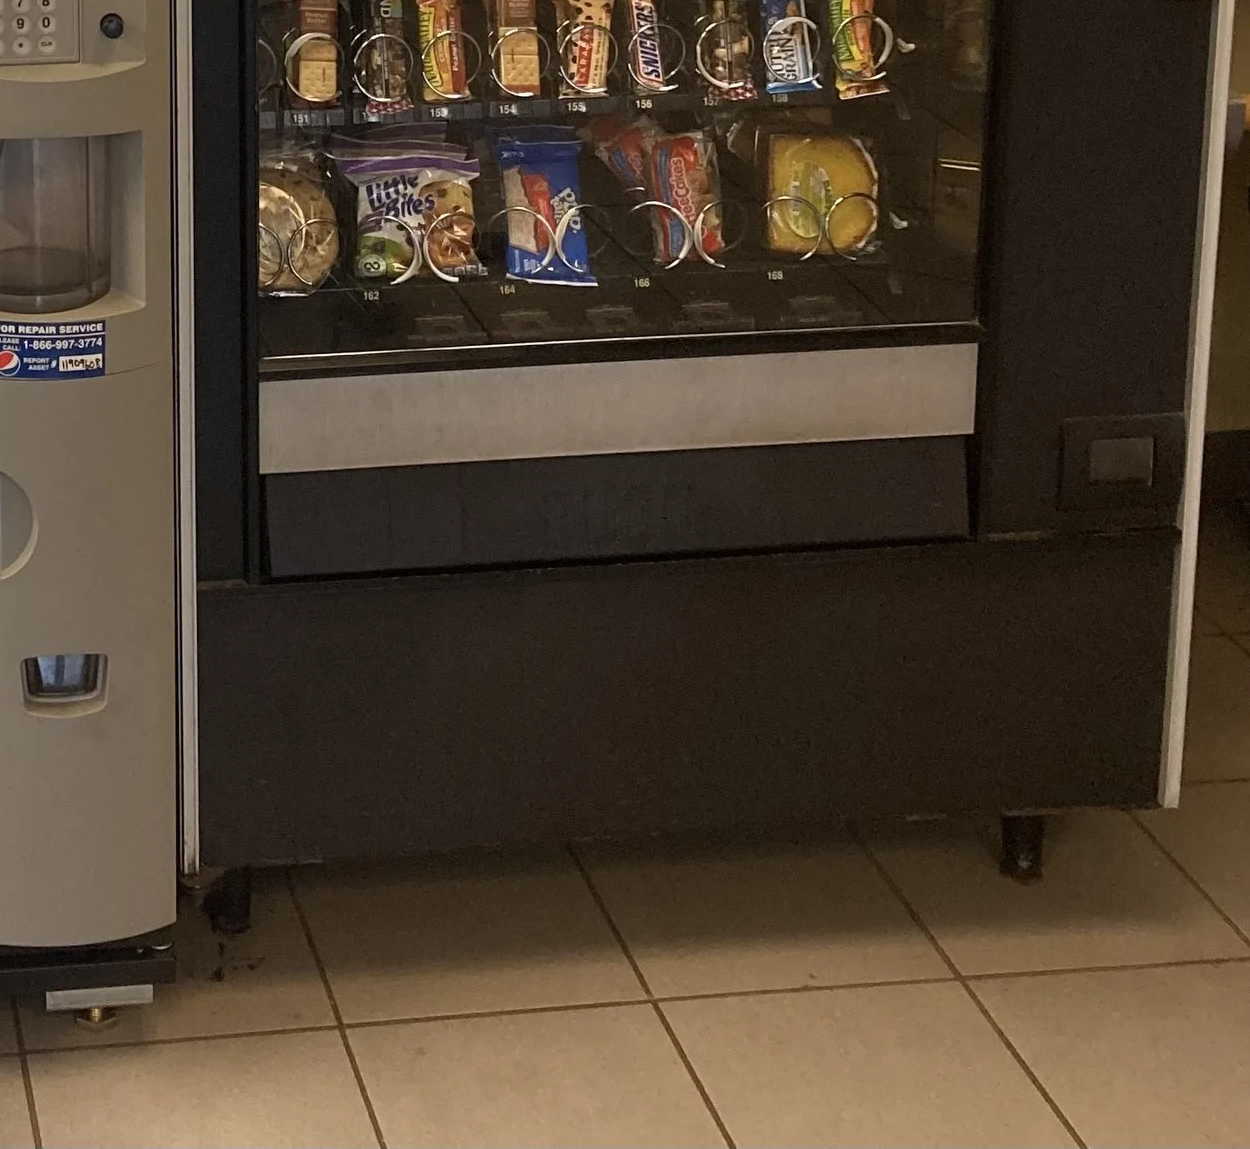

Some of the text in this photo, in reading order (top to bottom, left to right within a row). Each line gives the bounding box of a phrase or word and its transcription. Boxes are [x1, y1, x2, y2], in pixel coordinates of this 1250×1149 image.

[16, 18, 24, 29] 9
[42, 17, 50, 28] 0
[636, 0, 661, 83] SNICKERS
[430, 108, 446, 117] 153
[499, 105, 515, 114] 154
[293, 114, 309, 123] 151
[365, 174, 419, 211] Little
[384, 191, 436, 221] Bites
[500, 285, 516, 294] 164
[363, 291, 379, 300] 162
[18, 326, 56, 334] REPAIR
[59, 323, 103, 333] SERVICE
[24, 337, 102, 349] 1-866-997-3774
